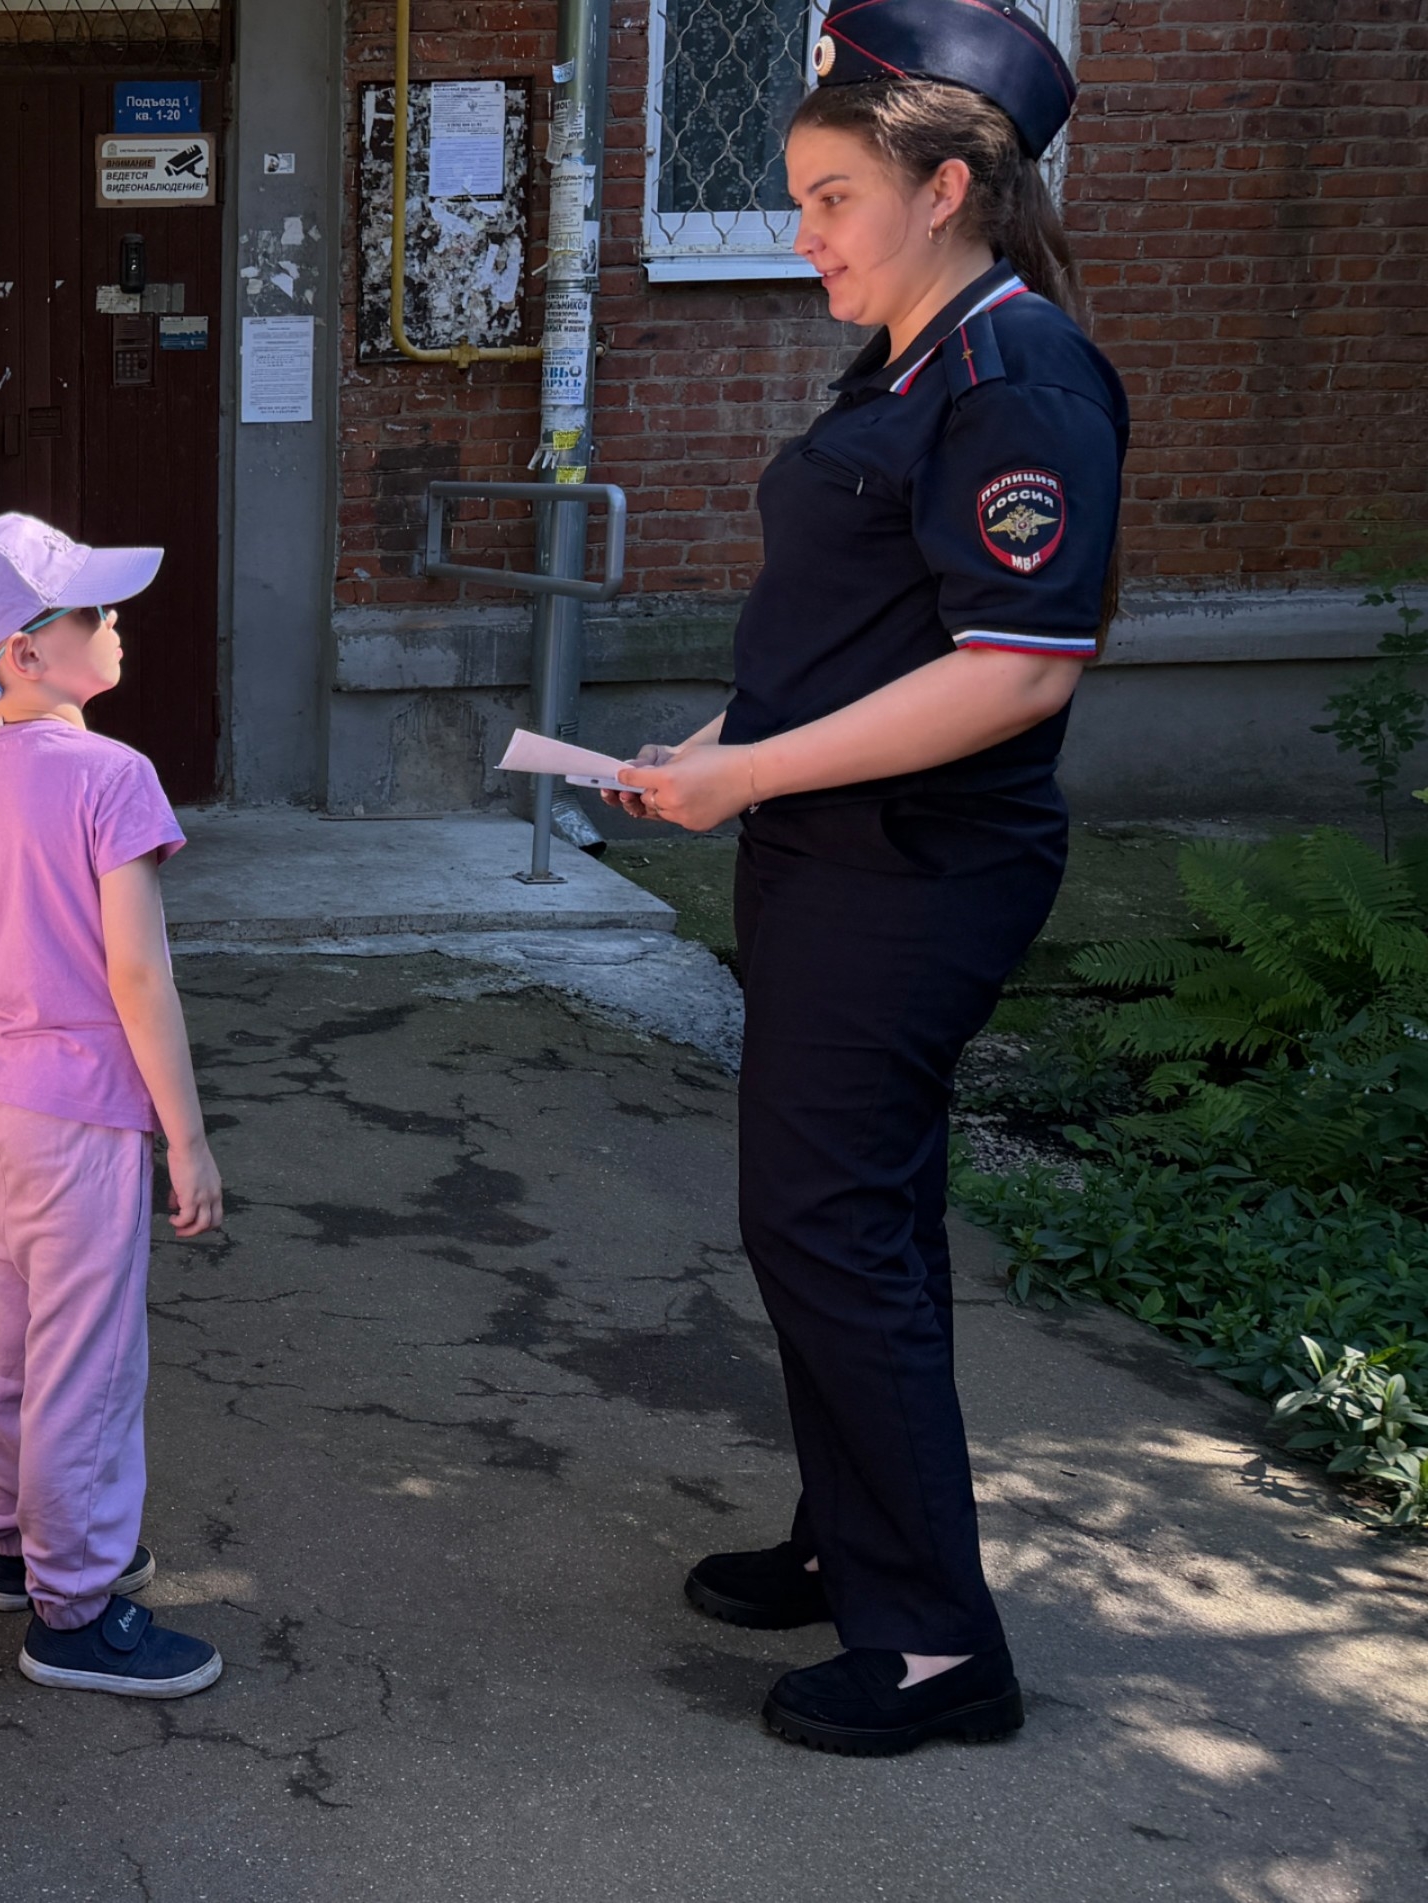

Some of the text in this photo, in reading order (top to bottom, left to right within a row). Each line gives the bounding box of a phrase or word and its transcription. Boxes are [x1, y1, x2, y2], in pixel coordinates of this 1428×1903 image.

[126, 96, 189, 108] Подъезд 1
[135, 110, 181, 121] кв. 1-20
[106, 159, 154, 168] ВНИМАНИЕ
[106, 172, 148, 181] ВЕДЕТСЯ
[106, 183, 204, 193] ВИДЕОНАБЛЮДЕНИЕ!
[981, 473, 1059, 503] ПОЛИЦИЯ
[988, 489, 1054, 520] РОССИЯ
[1010, 552, 1041, 571] МВД
